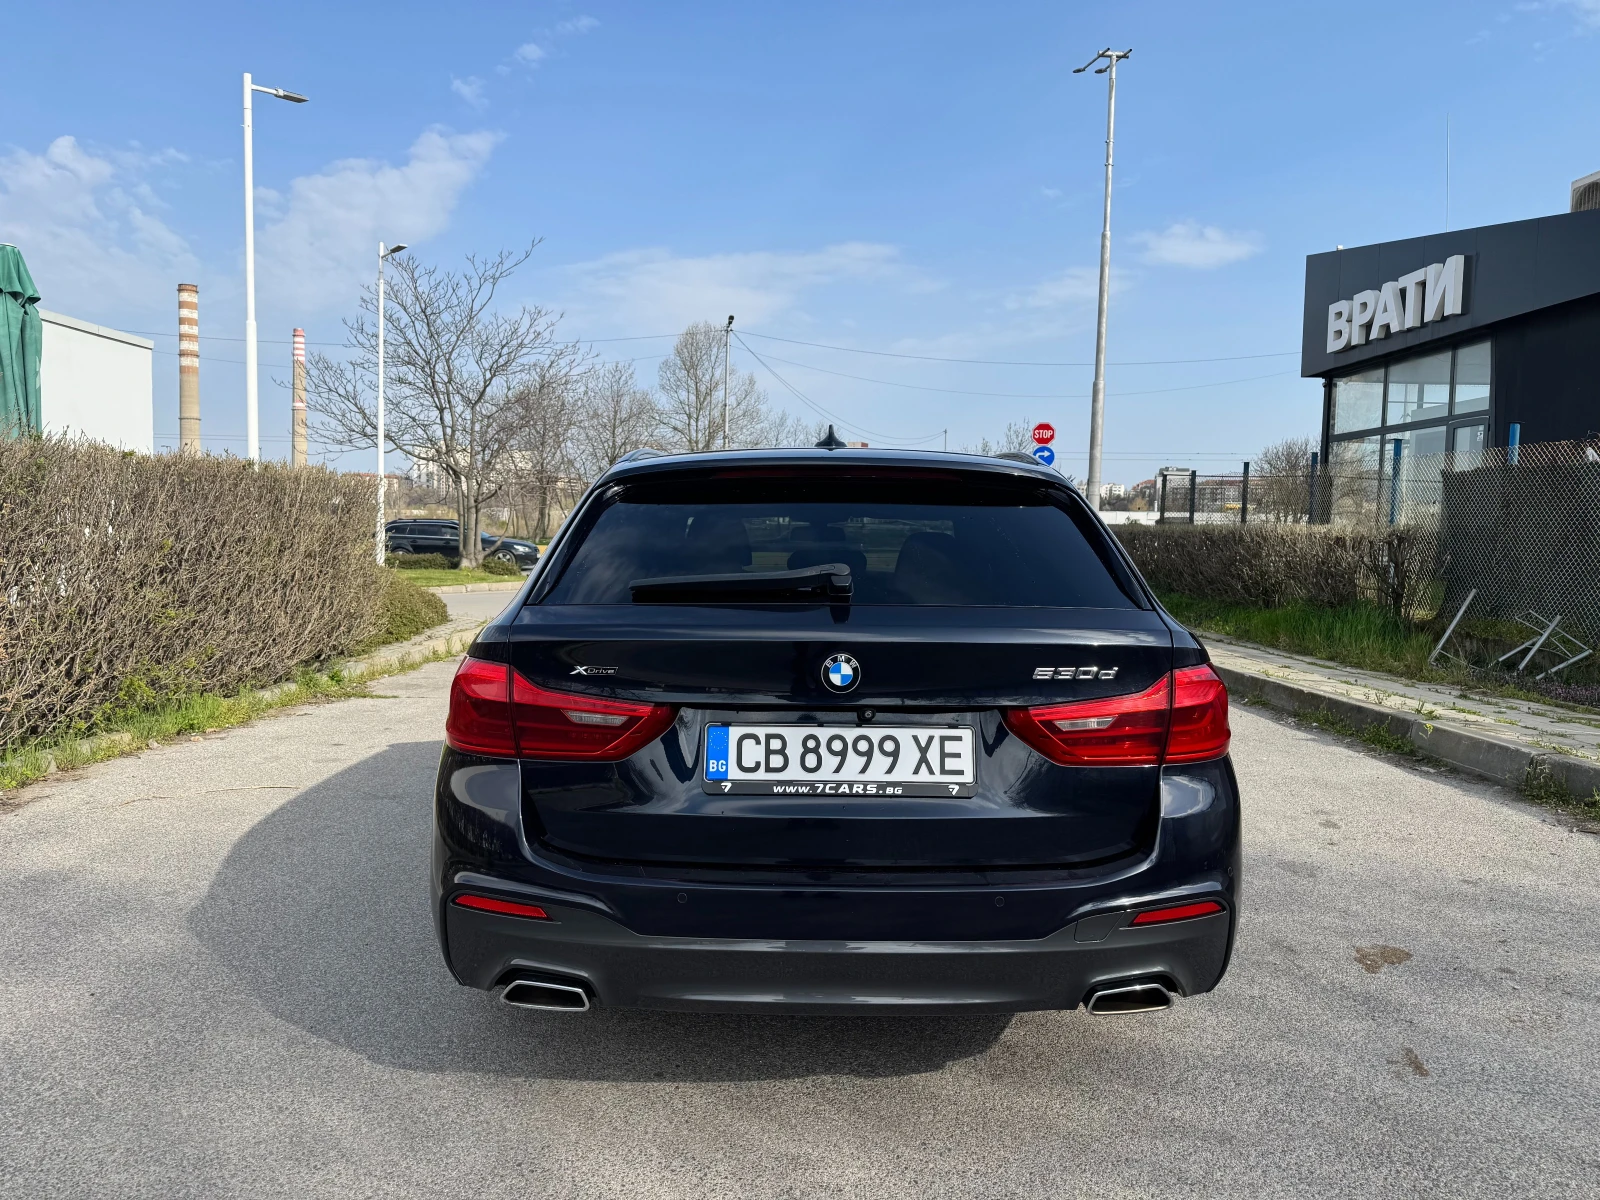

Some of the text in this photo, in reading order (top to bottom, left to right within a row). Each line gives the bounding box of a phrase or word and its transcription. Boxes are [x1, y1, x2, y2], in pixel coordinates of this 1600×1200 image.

[1326, 254, 1465, 354] ВРАТИ
[1034, 429, 1053, 439] STOP
[825, 655, 858, 669] BMW
[1032, 666, 1119, 680] 530d
[736, 733, 965, 776] CB 8999 XE
[709, 760, 726, 772] BG
